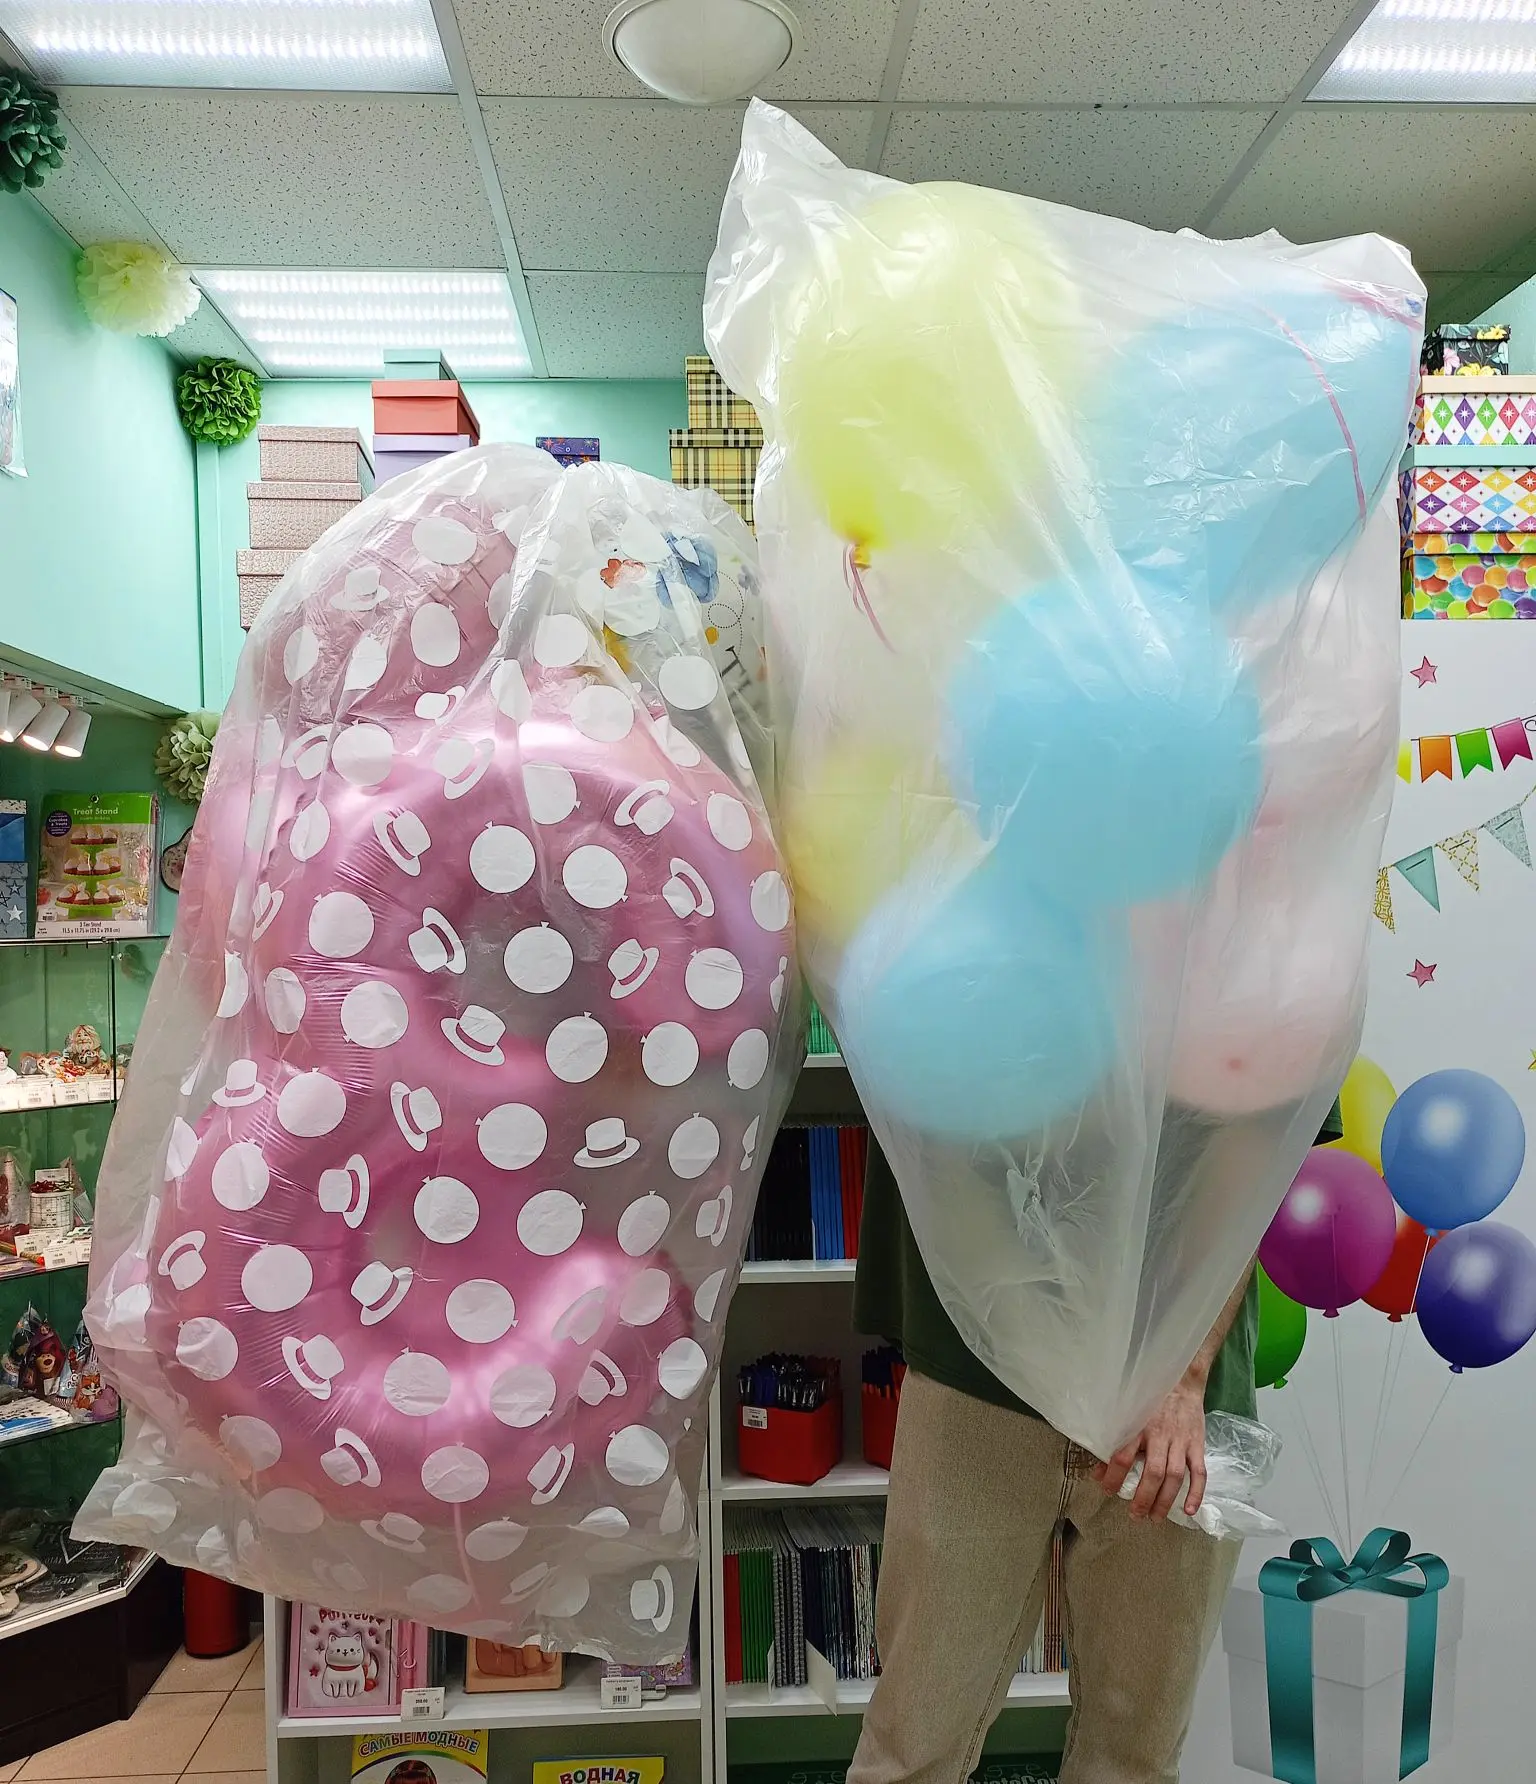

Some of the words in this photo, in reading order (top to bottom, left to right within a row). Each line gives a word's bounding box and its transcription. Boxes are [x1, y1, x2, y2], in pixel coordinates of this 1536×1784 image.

[95, 807, 119, 815] Stand
[359, 1732, 412, 1757] САМЫЕ
[414, 1730, 480, 1755] МОДНЫЕ
[559, 1766, 641, 1784] ВОДНАЯ
